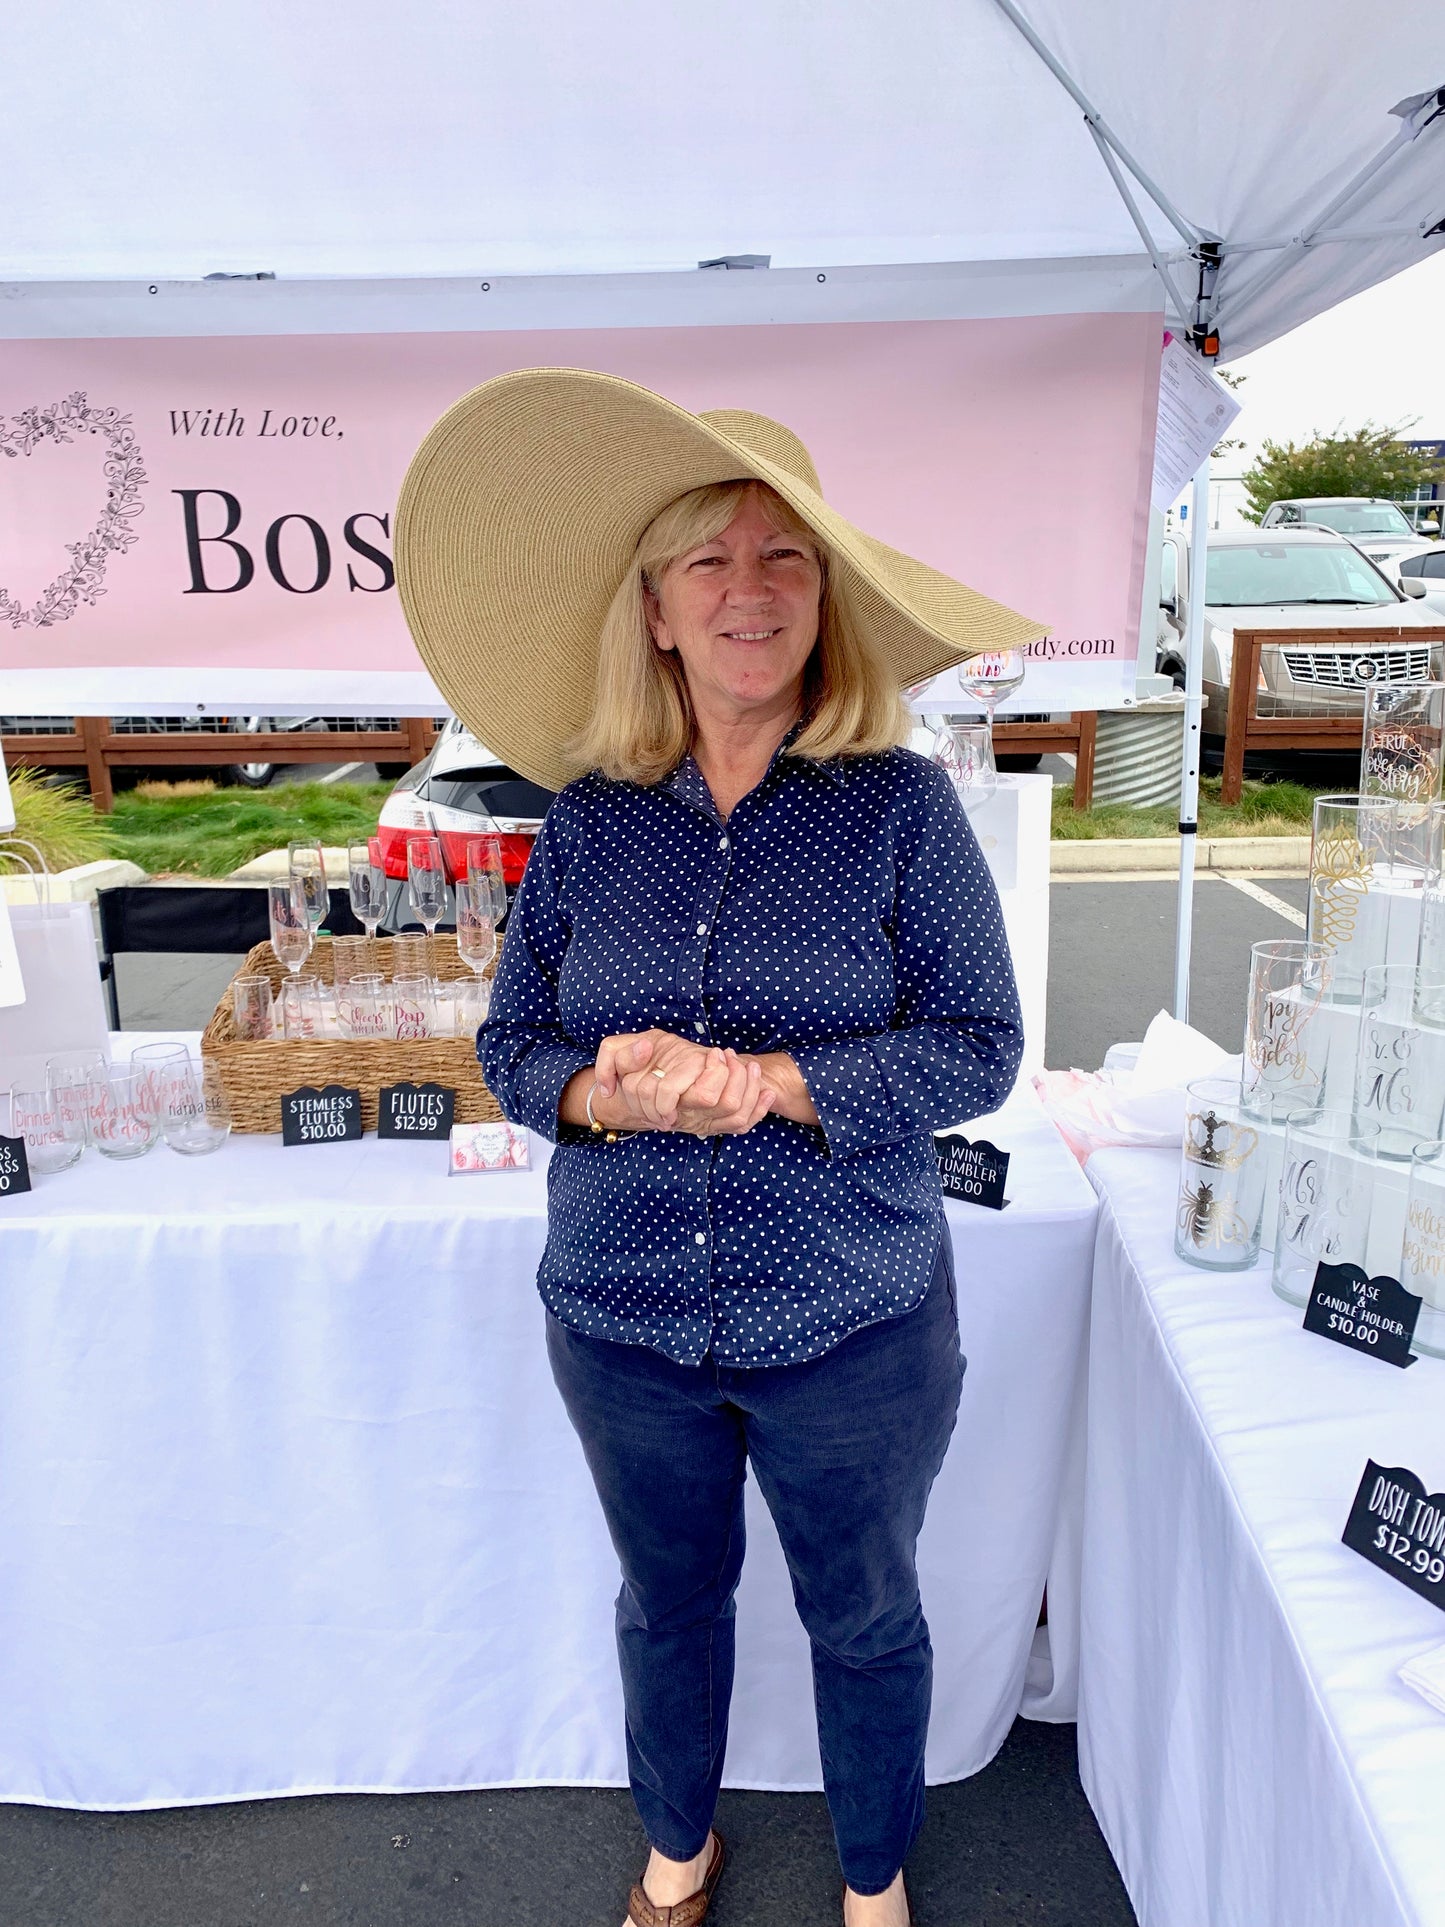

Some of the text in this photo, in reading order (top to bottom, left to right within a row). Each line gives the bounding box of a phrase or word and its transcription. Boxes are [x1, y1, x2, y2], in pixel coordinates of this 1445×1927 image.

[168, 408, 345, 441] With Love,
[290, 1096, 353, 1114] STEMLESS
[391, 1093, 444, 1115] FLUTES
[299, 1110, 345, 1126] FLUTES
[394, 1115, 437, 1131] $12.99
[301, 1123, 346, 1140] $10.00
[951, 1145, 986, 1167] WINE
[937, 1156, 997, 1184] TUMBLER
[941, 1173, 983, 1196] $15.00
[1352, 1280, 1381, 1301] VASE
[1357, 1295, 1366, 1308] &
[1317, 1292, 1404, 1336] CANDLE HOLDER
[1327, 1313, 1379, 1345] $10.00
[1368, 1475, 1411, 1526] DISH
[1373, 1524, 1445, 1583] $12.99
